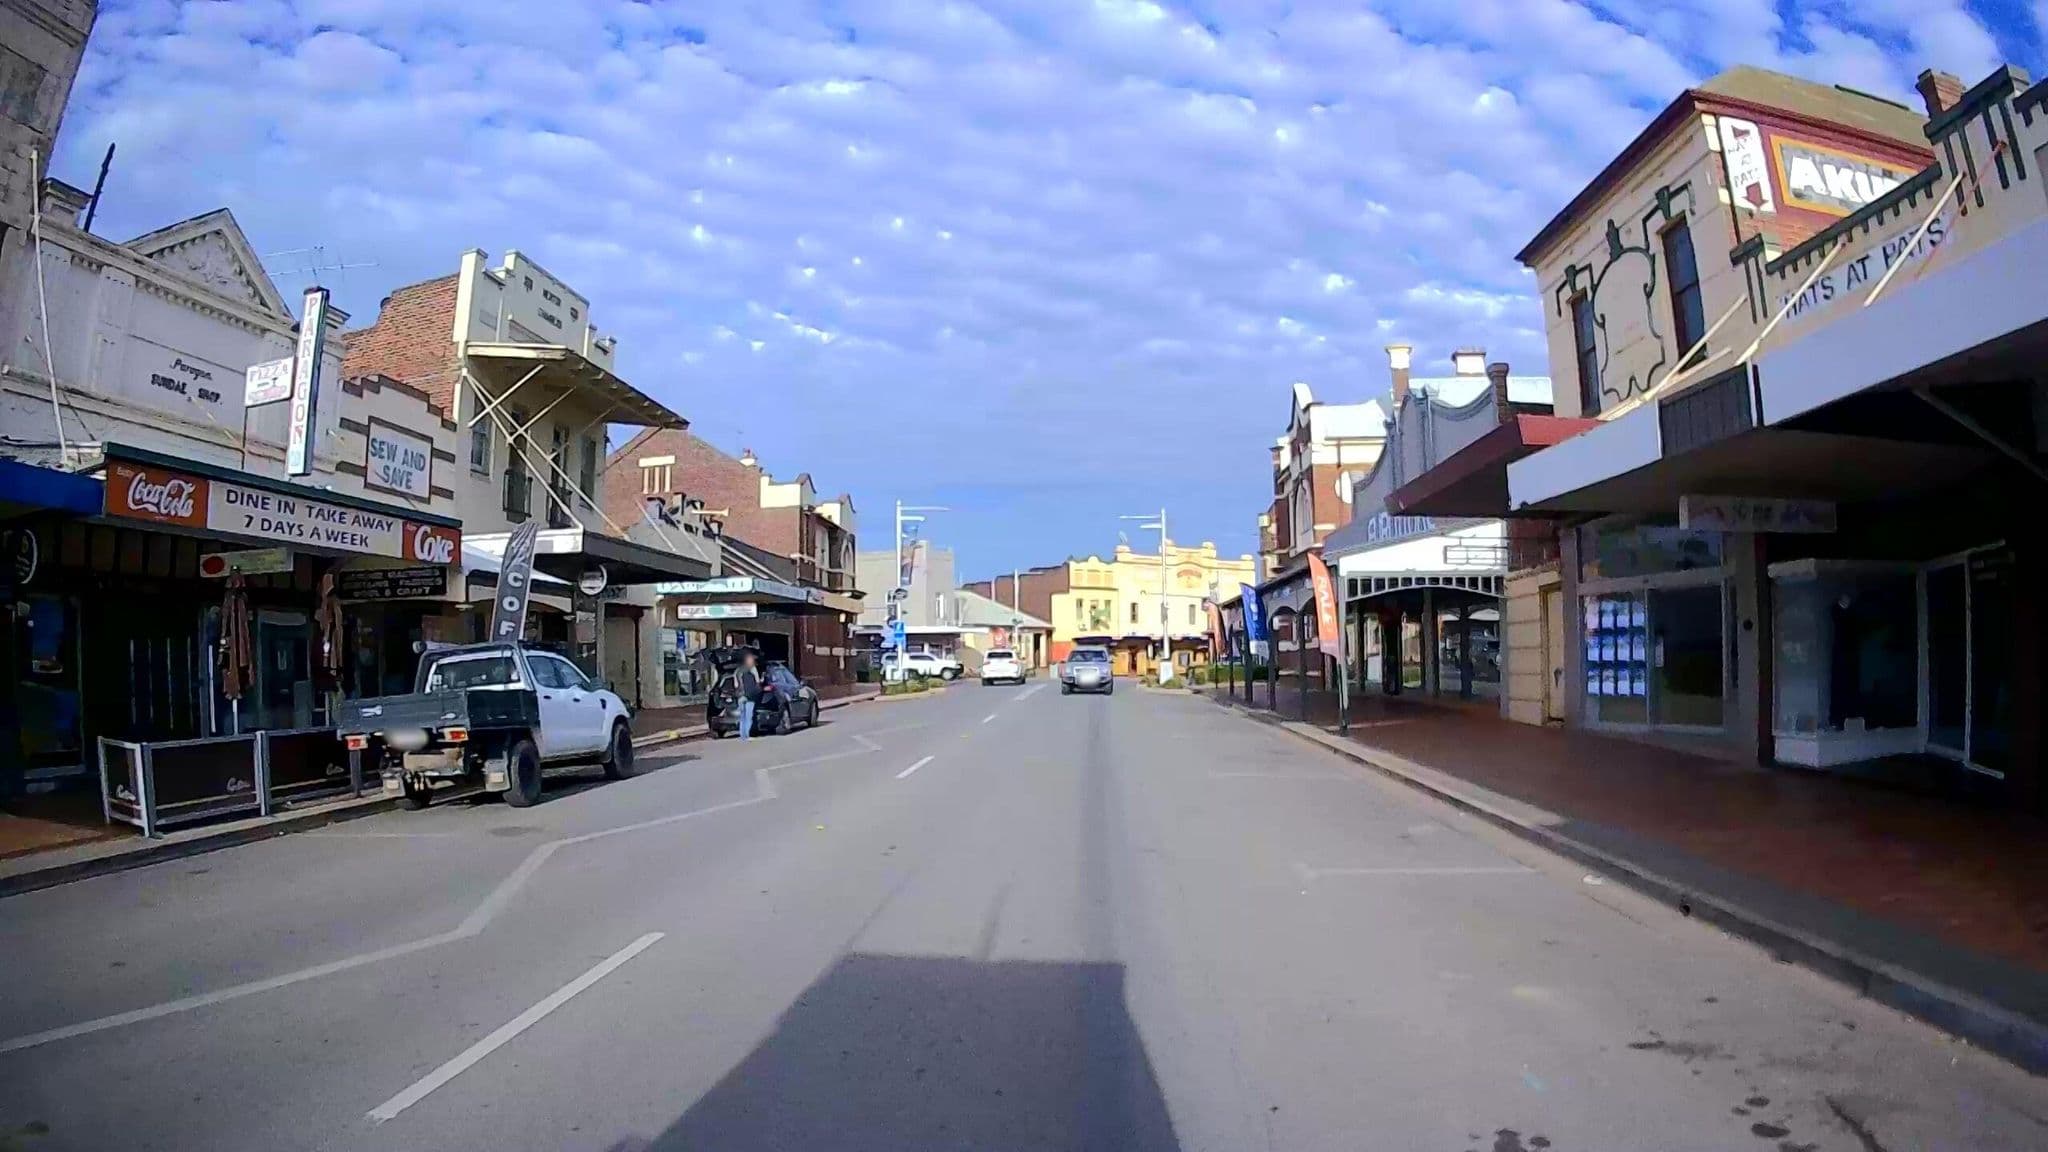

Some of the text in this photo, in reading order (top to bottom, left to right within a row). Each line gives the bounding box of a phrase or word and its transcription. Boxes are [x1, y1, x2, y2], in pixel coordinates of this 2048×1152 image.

[1847, 253, 1871, 291] AT
[293, 296, 318, 446] PARAGON
[370, 437, 426, 472] SEW AND
[375, 464, 413, 490] SAVE
[226, 489, 271, 511] DINE
[277, 499, 296, 515] IN
[306, 504, 347, 525] TAKE
[351, 513, 394, 533] AWAY
[243, 514, 369, 548] 7 DAYS A WEEK
[414, 525, 455, 564] Coke
